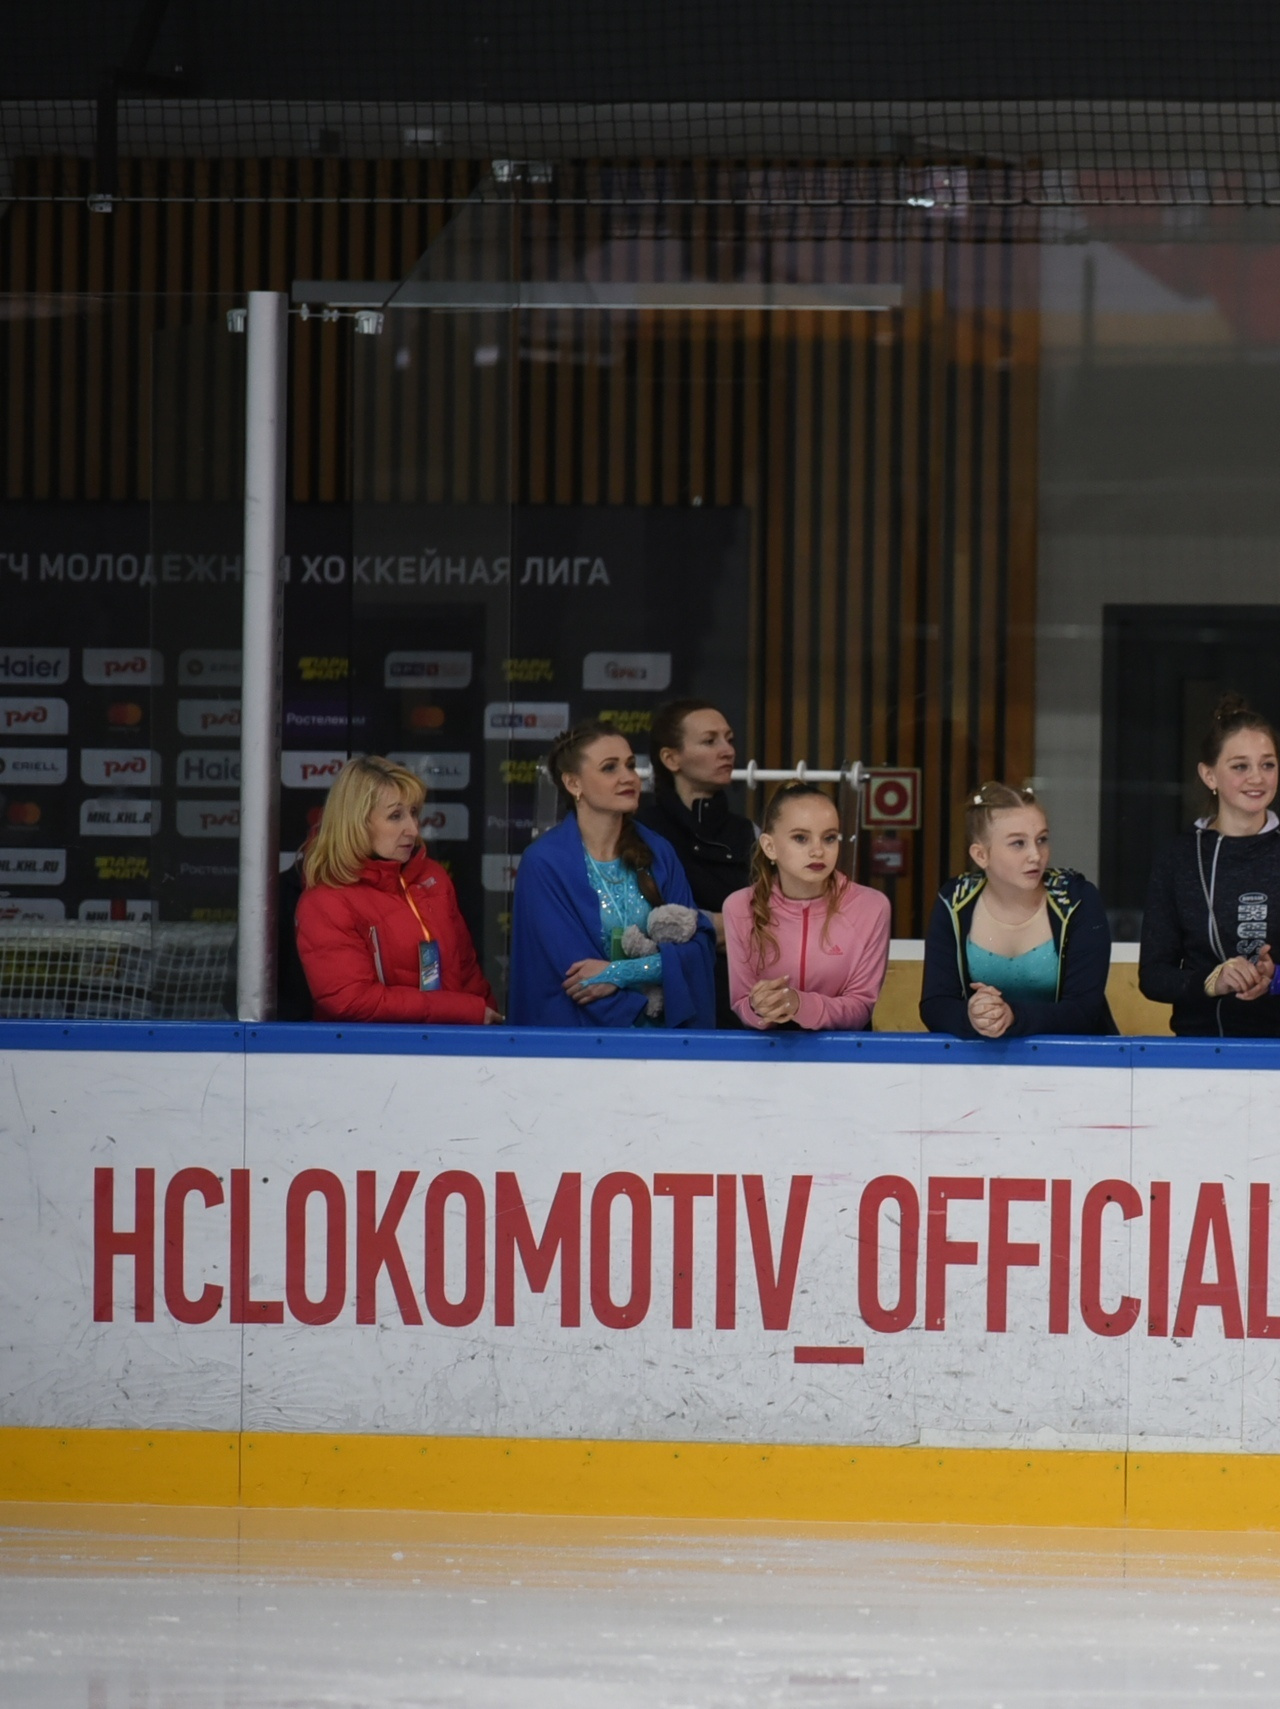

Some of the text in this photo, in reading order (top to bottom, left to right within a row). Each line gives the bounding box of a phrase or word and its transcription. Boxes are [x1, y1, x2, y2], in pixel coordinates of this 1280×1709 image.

[40, 553, 290, 586] МОЛОДЕЖН
[301, 549, 510, 585] ХОККЕЙНАЯ
[520, 557, 610, 586] ЛИГА
[12, 762, 59, 772] ERIELL
[184, 761, 241, 781] Haie
